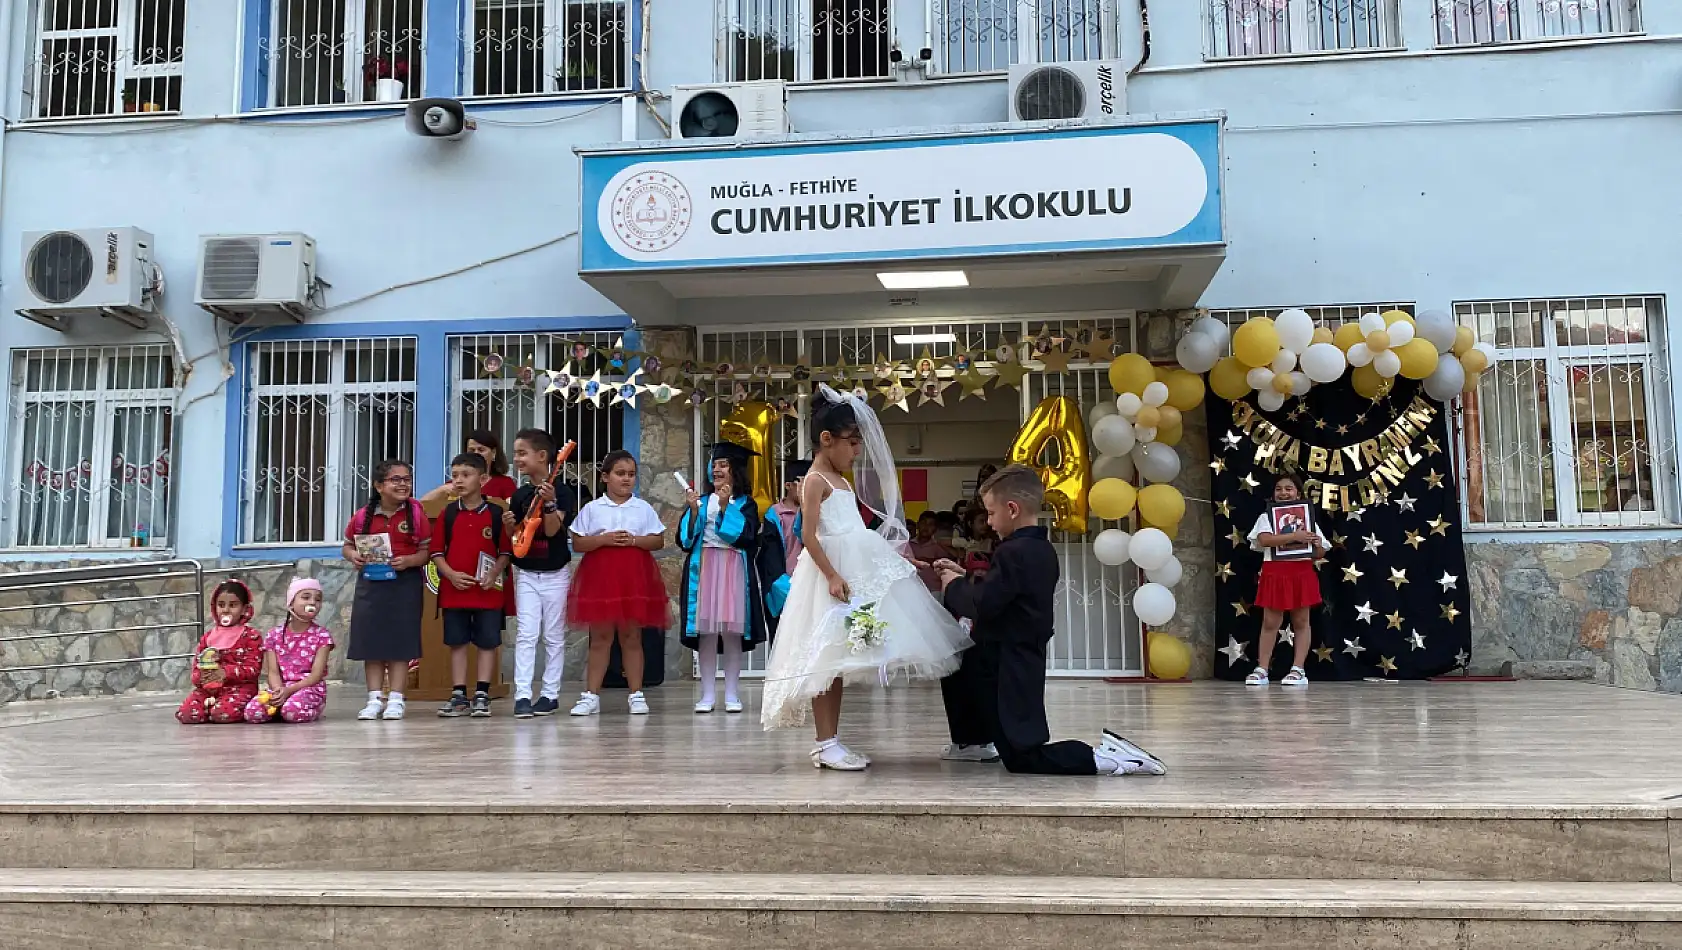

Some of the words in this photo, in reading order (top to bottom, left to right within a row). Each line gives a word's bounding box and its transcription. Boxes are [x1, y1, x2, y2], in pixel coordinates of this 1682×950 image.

[1097, 65, 1117, 115] arçelik
[710, 181, 773, 199] MUĞLA
[789, 175, 858, 196] FETHİYE
[710, 193, 941, 235] CUMHURİYET
[954, 187, 1132, 223] İLKOKULU
